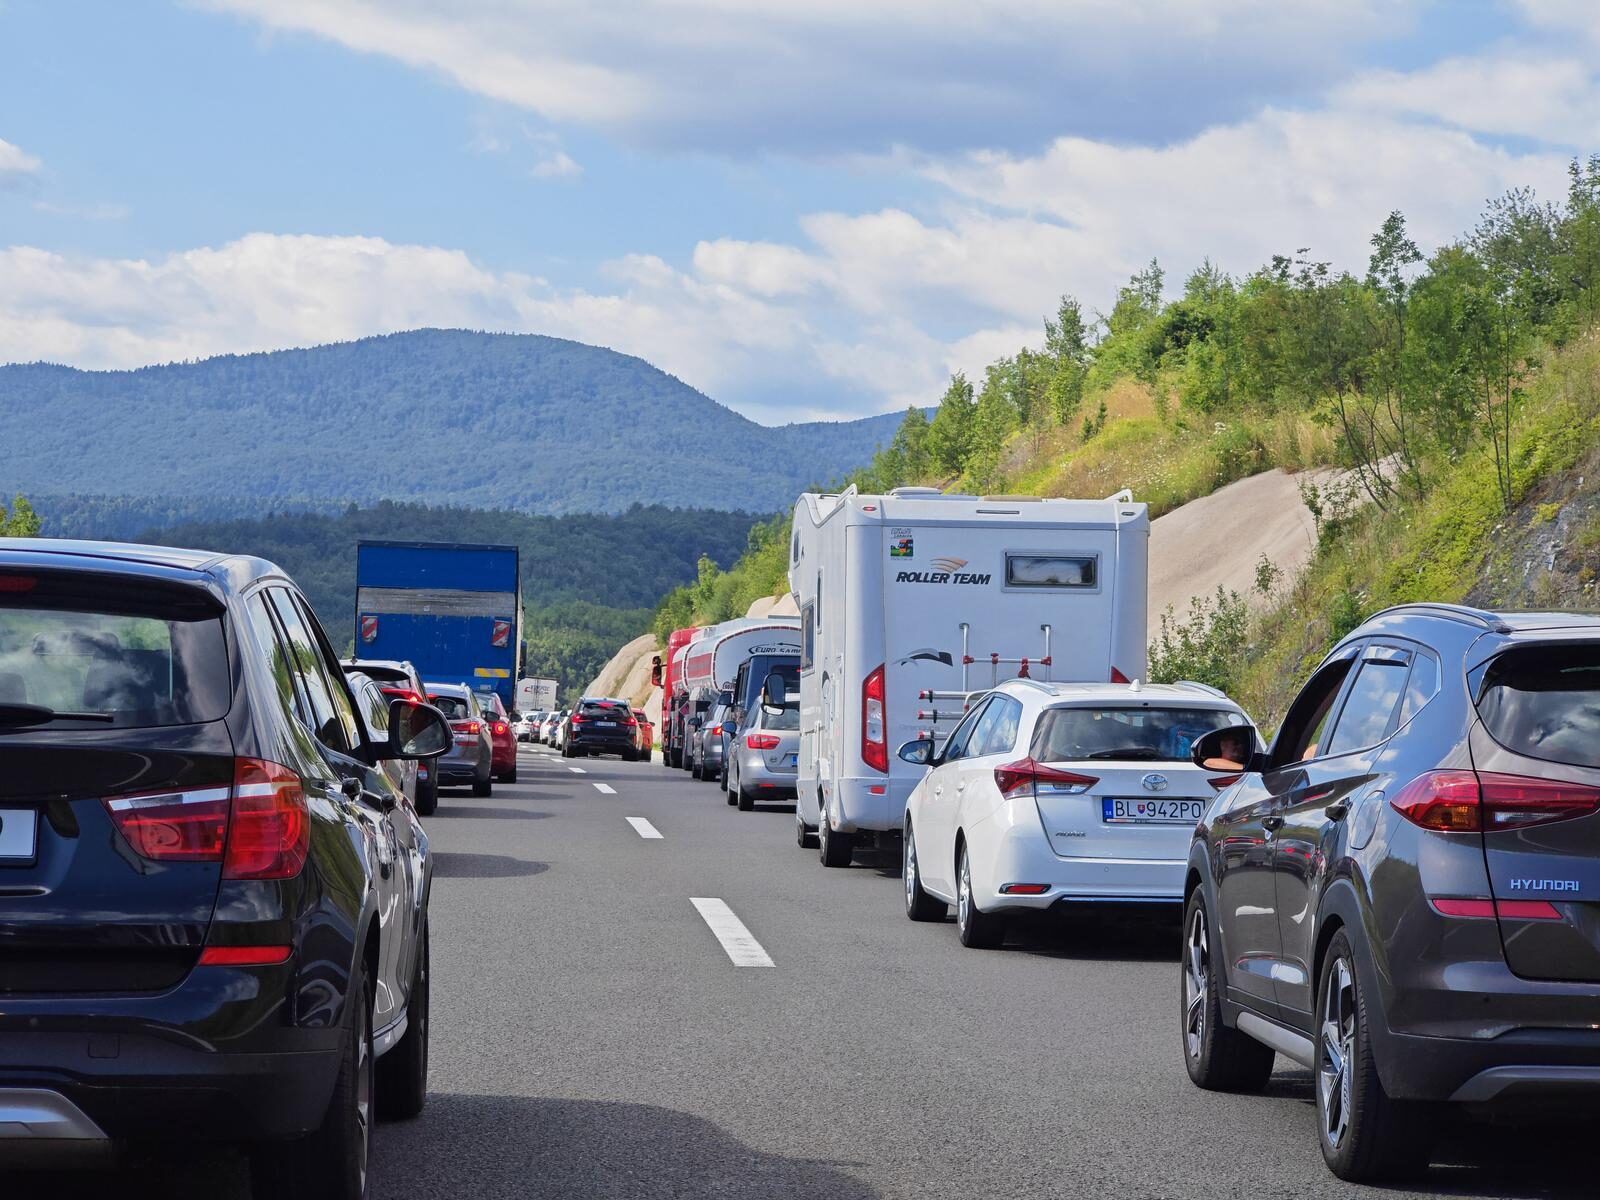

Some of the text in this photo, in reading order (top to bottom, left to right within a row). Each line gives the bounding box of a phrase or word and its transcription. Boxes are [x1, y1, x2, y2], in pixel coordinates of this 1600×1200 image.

[896, 571, 991, 585] ROLLER TEAM
[1115, 801, 1137, 817] BL
[1510, 879, 1580, 892] HYUNDAI
